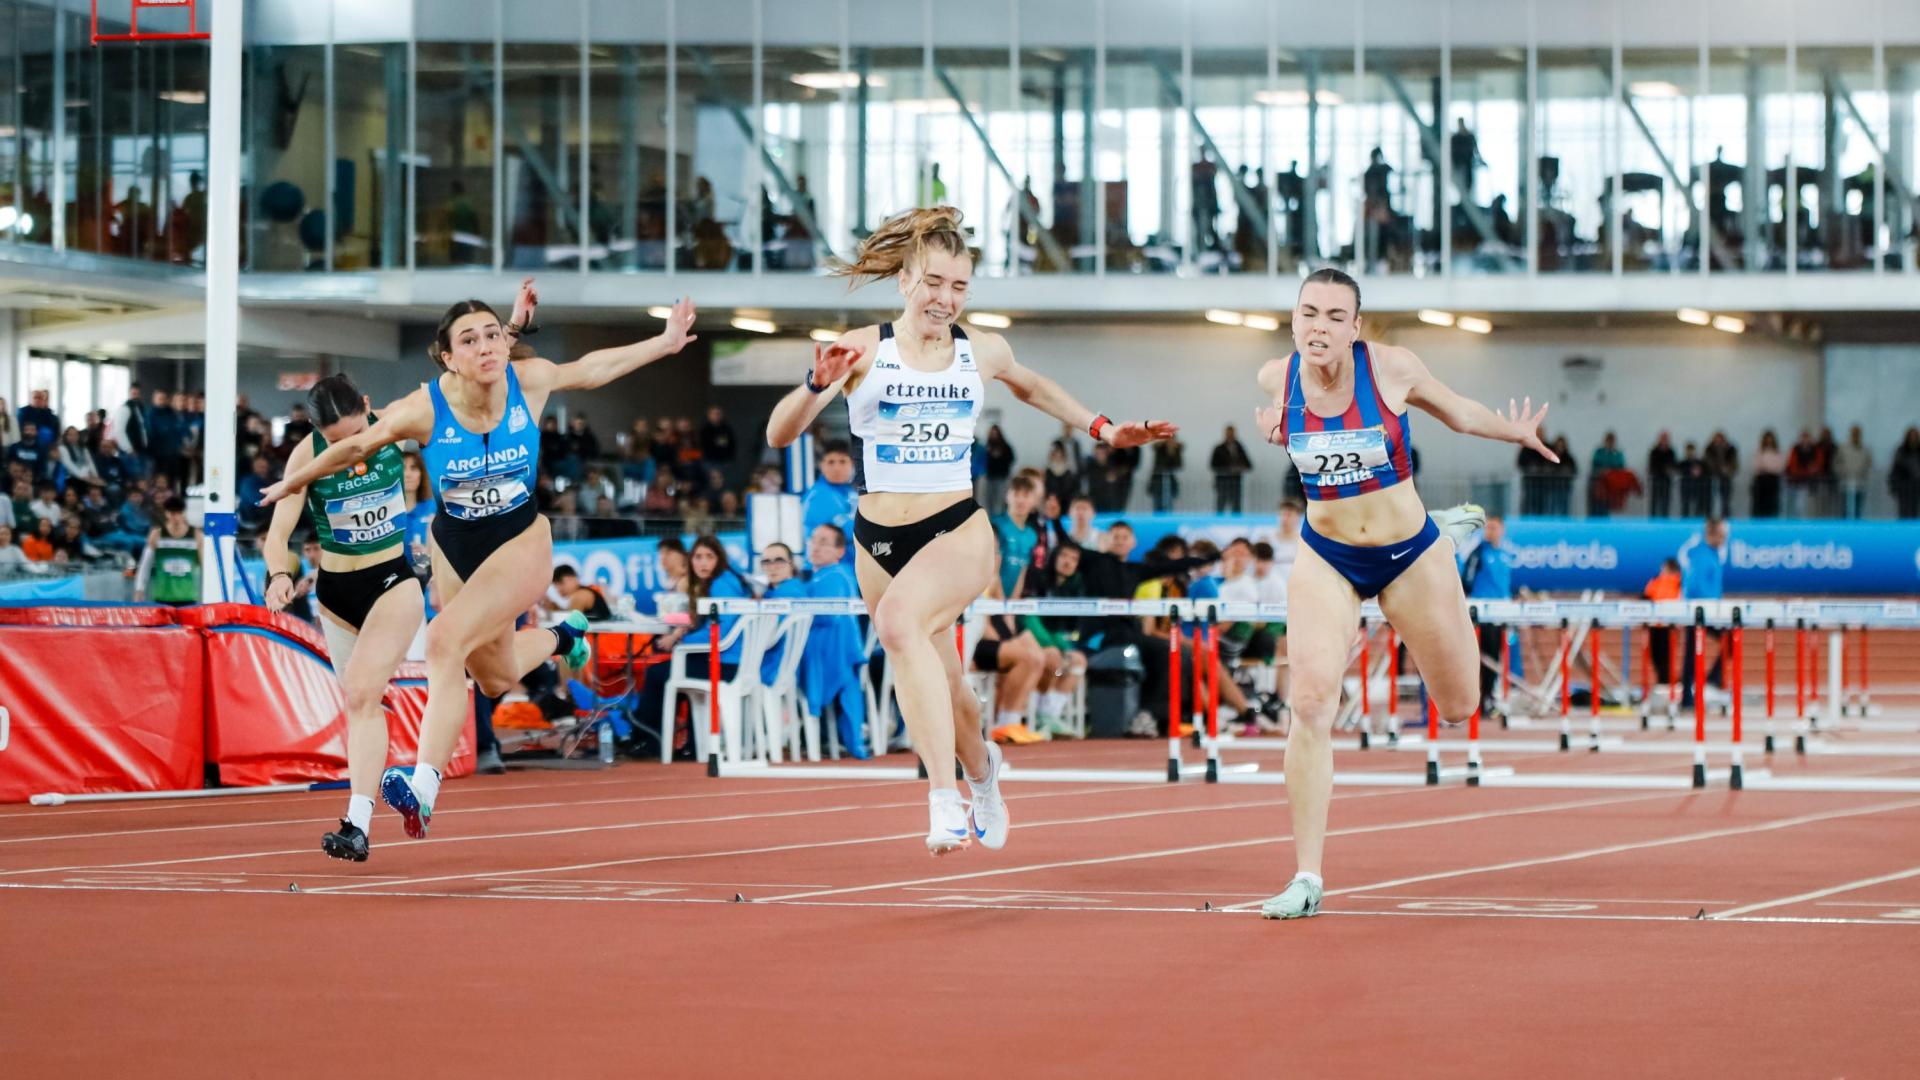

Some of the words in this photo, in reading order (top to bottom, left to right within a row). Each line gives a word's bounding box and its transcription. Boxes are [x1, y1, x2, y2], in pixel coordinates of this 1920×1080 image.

[901, 423, 950, 442] 250
[446, 444, 529, 471] ARGANDA
[894, 446, 955, 463] Joma
[1314, 452, 1364, 472] 223
[471, 487, 500, 506] 60
[350, 506, 388, 528] 100
[348, 520, 396, 543] Joma
[1501, 538, 1618, 570] berdrola
